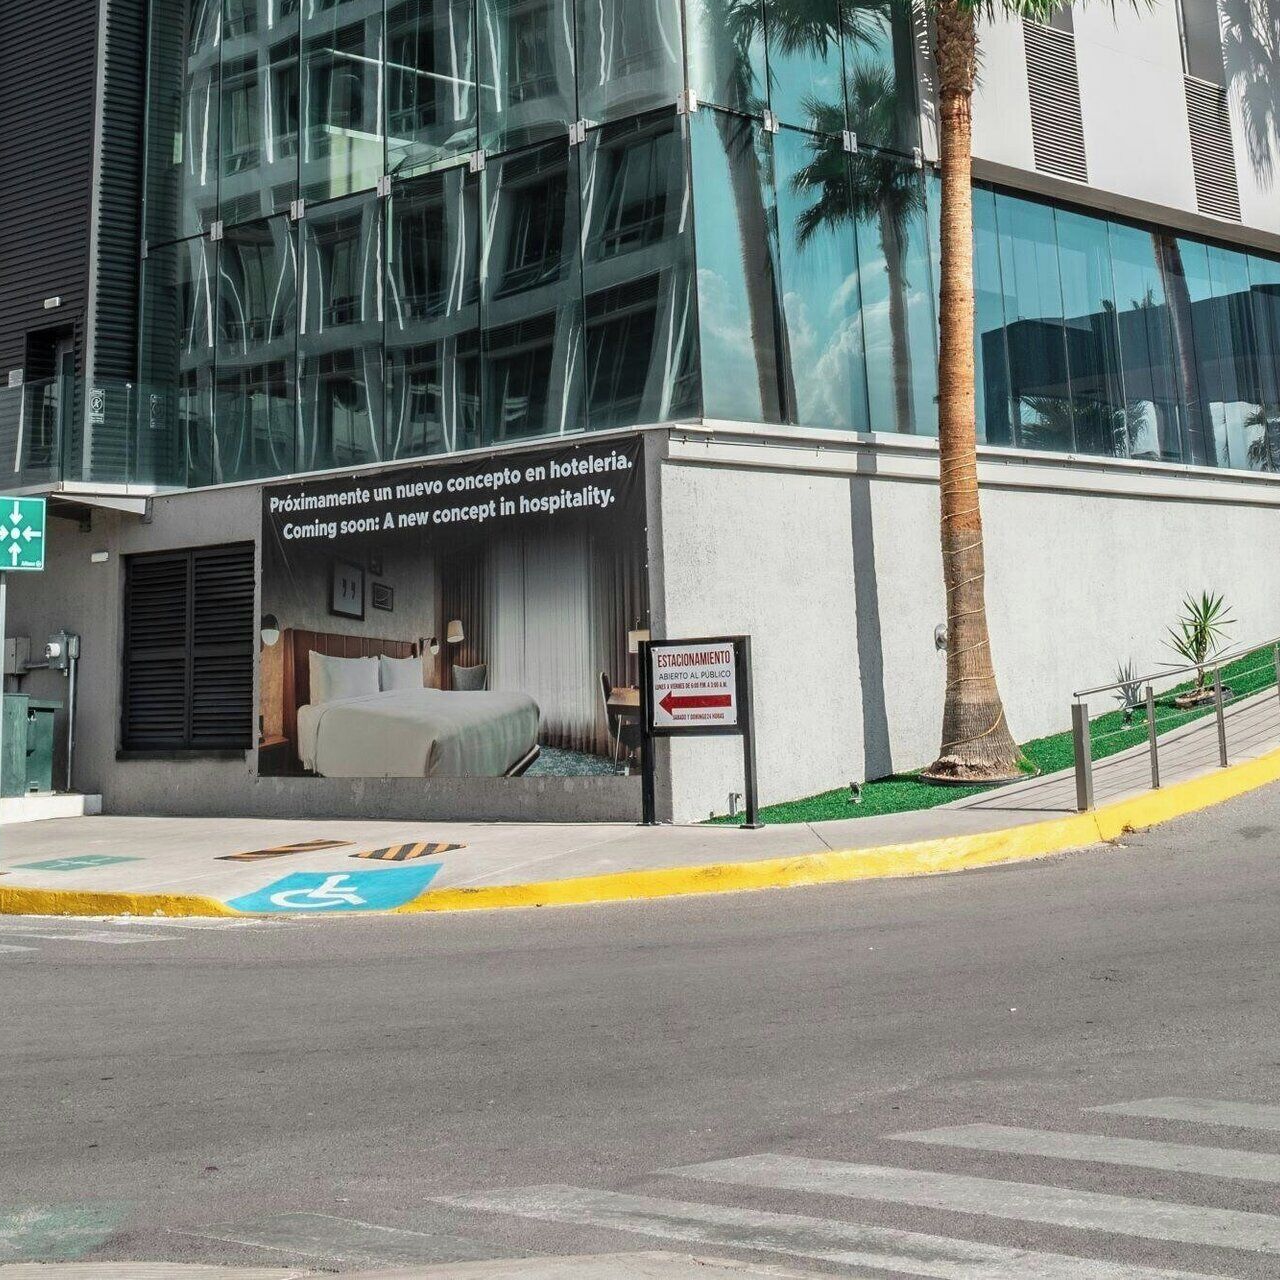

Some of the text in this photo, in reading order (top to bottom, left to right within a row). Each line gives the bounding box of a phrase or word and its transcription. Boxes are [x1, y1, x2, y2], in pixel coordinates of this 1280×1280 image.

[269, 486, 371, 514] Próximamente
[373, 486, 393, 502] un
[395, 479, 443, 500] nuevo
[446, 467, 522, 493] concepto
[524, 466, 546, 482] en
[282, 484, 616, 540] Coming soon: A new concept in hospitality.
[657, 650, 730, 667] ESTACIONAMIENTO
[659, 668, 731, 680] ABIERTO AL PÚBLICO
